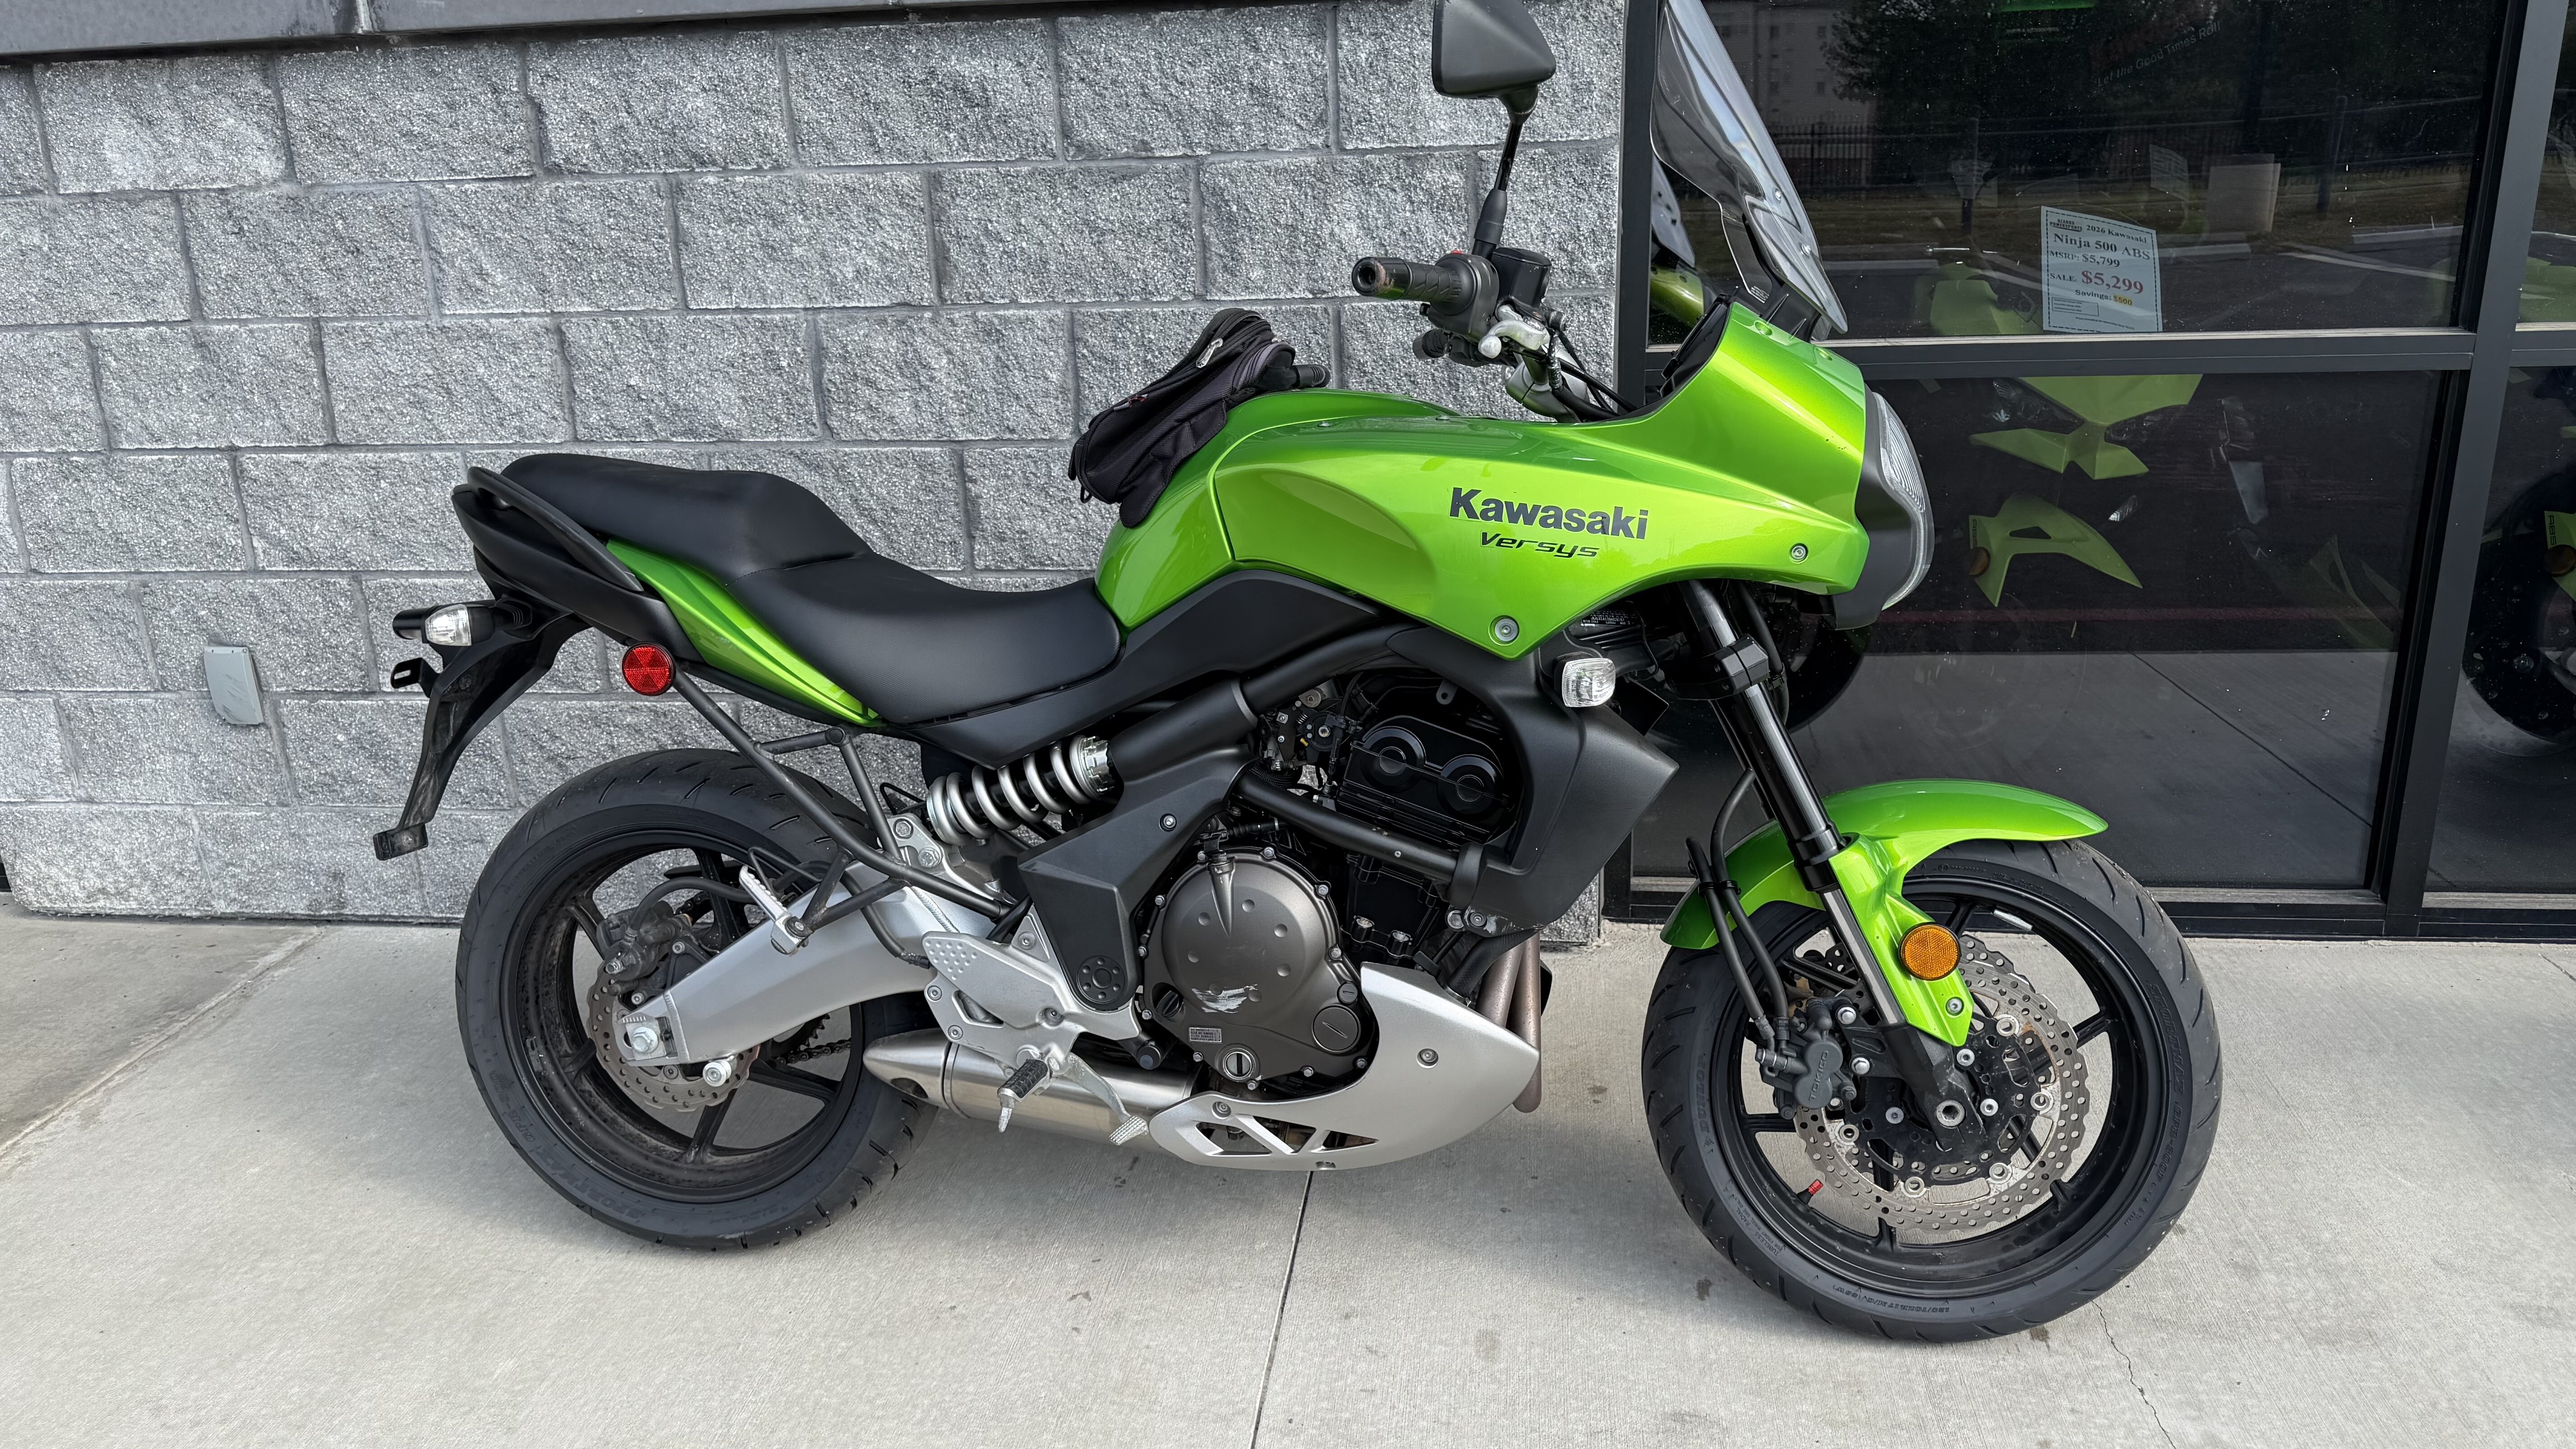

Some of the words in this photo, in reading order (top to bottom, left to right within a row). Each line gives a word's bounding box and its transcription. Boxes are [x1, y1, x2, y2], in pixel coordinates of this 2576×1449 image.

[2117, 65, 2133, 78] the
[2136, 49, 2164, 69] Good
[2165, 35, 2196, 55] Times
[2199, 21, 2221, 40] Roll
[2054, 233, 2090, 248] Ninja
[2095, 240, 2117, 252] 500
[2122, 246, 2150, 260] ABS
[2087, 225, 2105, 234] 2026
[2108, 229, 2147, 243] Kawasaki
[2050, 250, 2079, 261] MSRP:
[2082, 253, 2120, 267] $5,799
[2050, 273, 2077, 282] SALE:
[2081, 270, 2144, 294] $5,299
[2075, 290, 2112, 300] Savings:
[2113, 295, 2132, 306] $500
[1449, 487, 1649, 539] Kawasaki
[2548, 515, 2557, 545] ABS
[1481, 532, 1600, 558] Versys
[2147, 982, 2184, 1093] SPORTMAX
[1809, 1050, 1829, 1100] TOKICO
[1697, 1056, 1710, 1132] DUNLOP
[1735, 1208, 1750, 1226] RADIAL
[1754, 1231, 1779, 1256] TUBELESS
